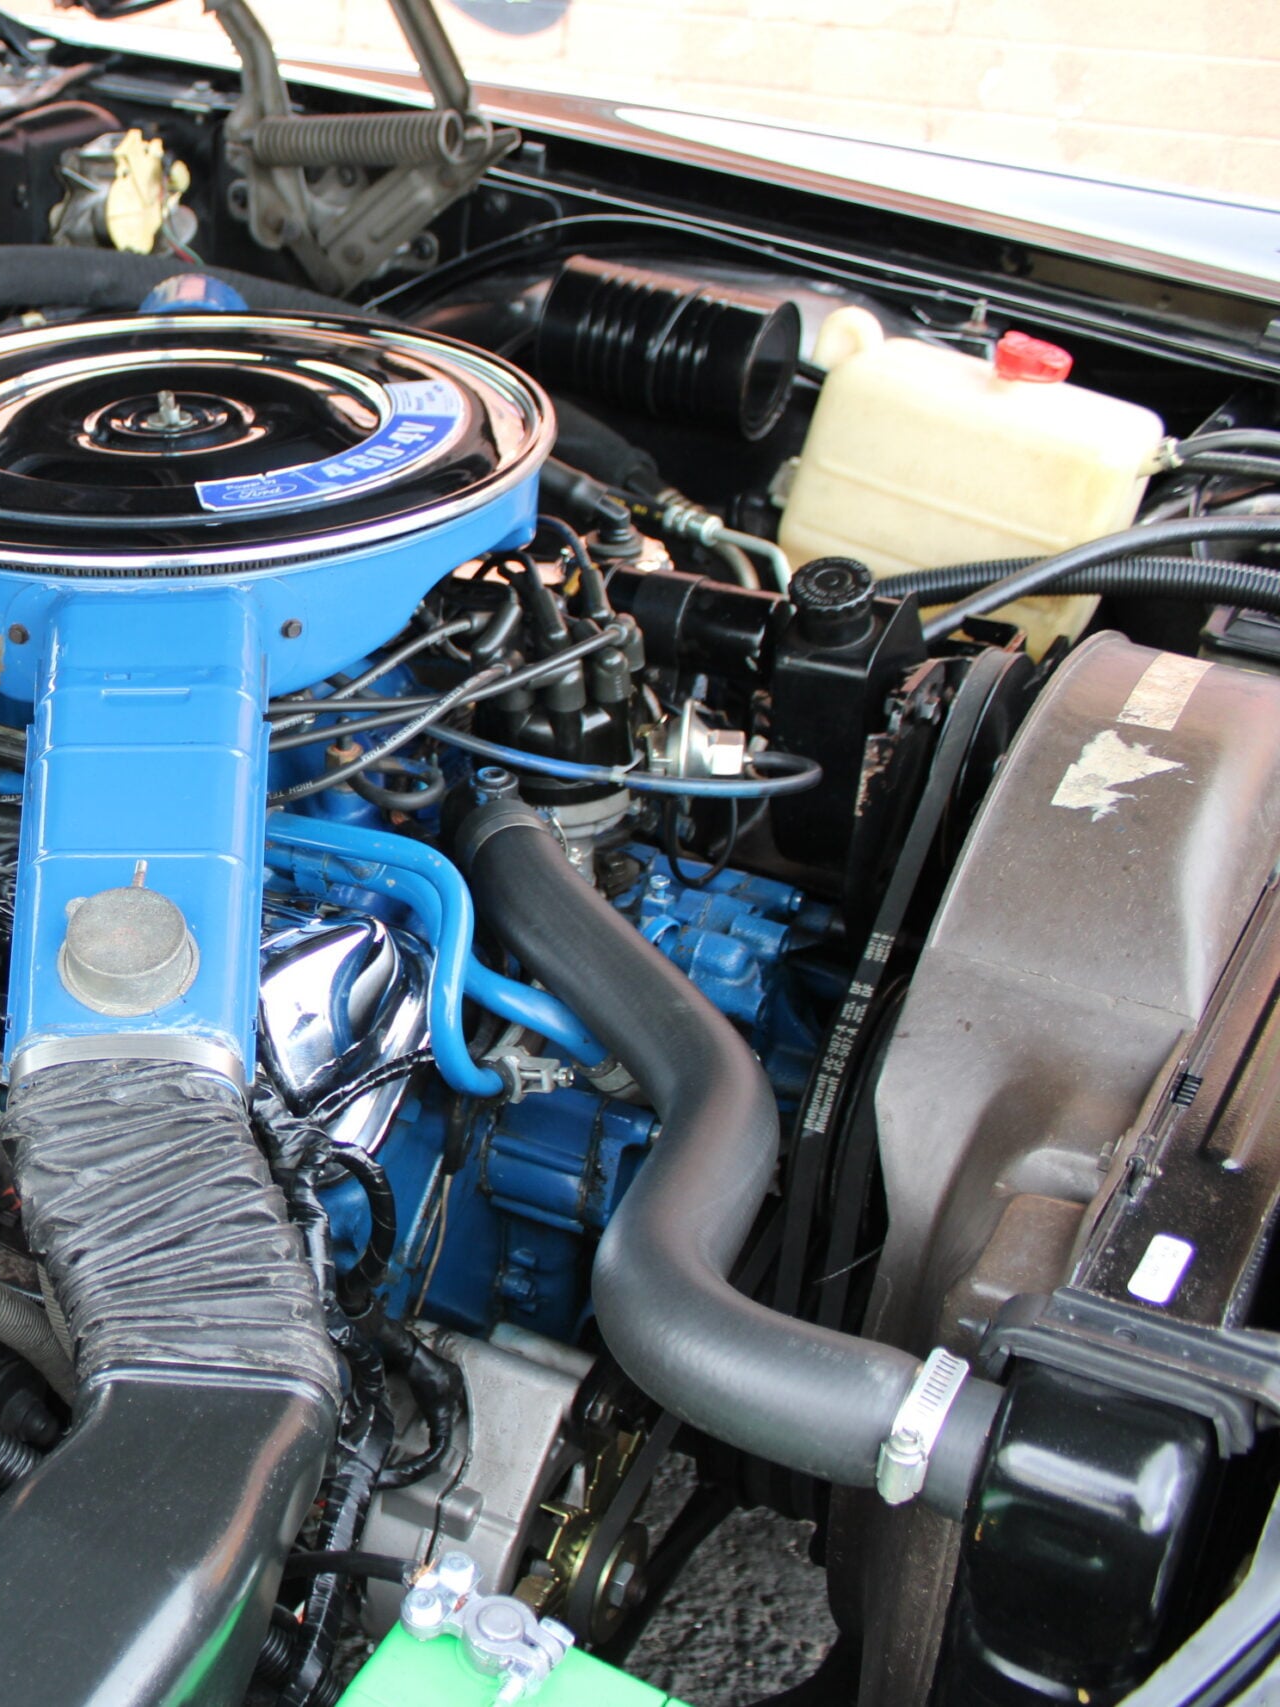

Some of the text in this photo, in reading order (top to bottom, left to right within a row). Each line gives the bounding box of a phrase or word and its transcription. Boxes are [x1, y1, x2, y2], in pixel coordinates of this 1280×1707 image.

[320, 421, 437, 479] 460-4V
[238, 485, 281, 499] Ford
[288, 780, 313, 795] HIGH
[804, 1073, 828, 1130] Motorcraft
[823, 1024, 847, 1071] JC-507-A
[814, 1077, 840, 1133] Motorcraft
[833, 1027, 858, 1075] JC-507-A
